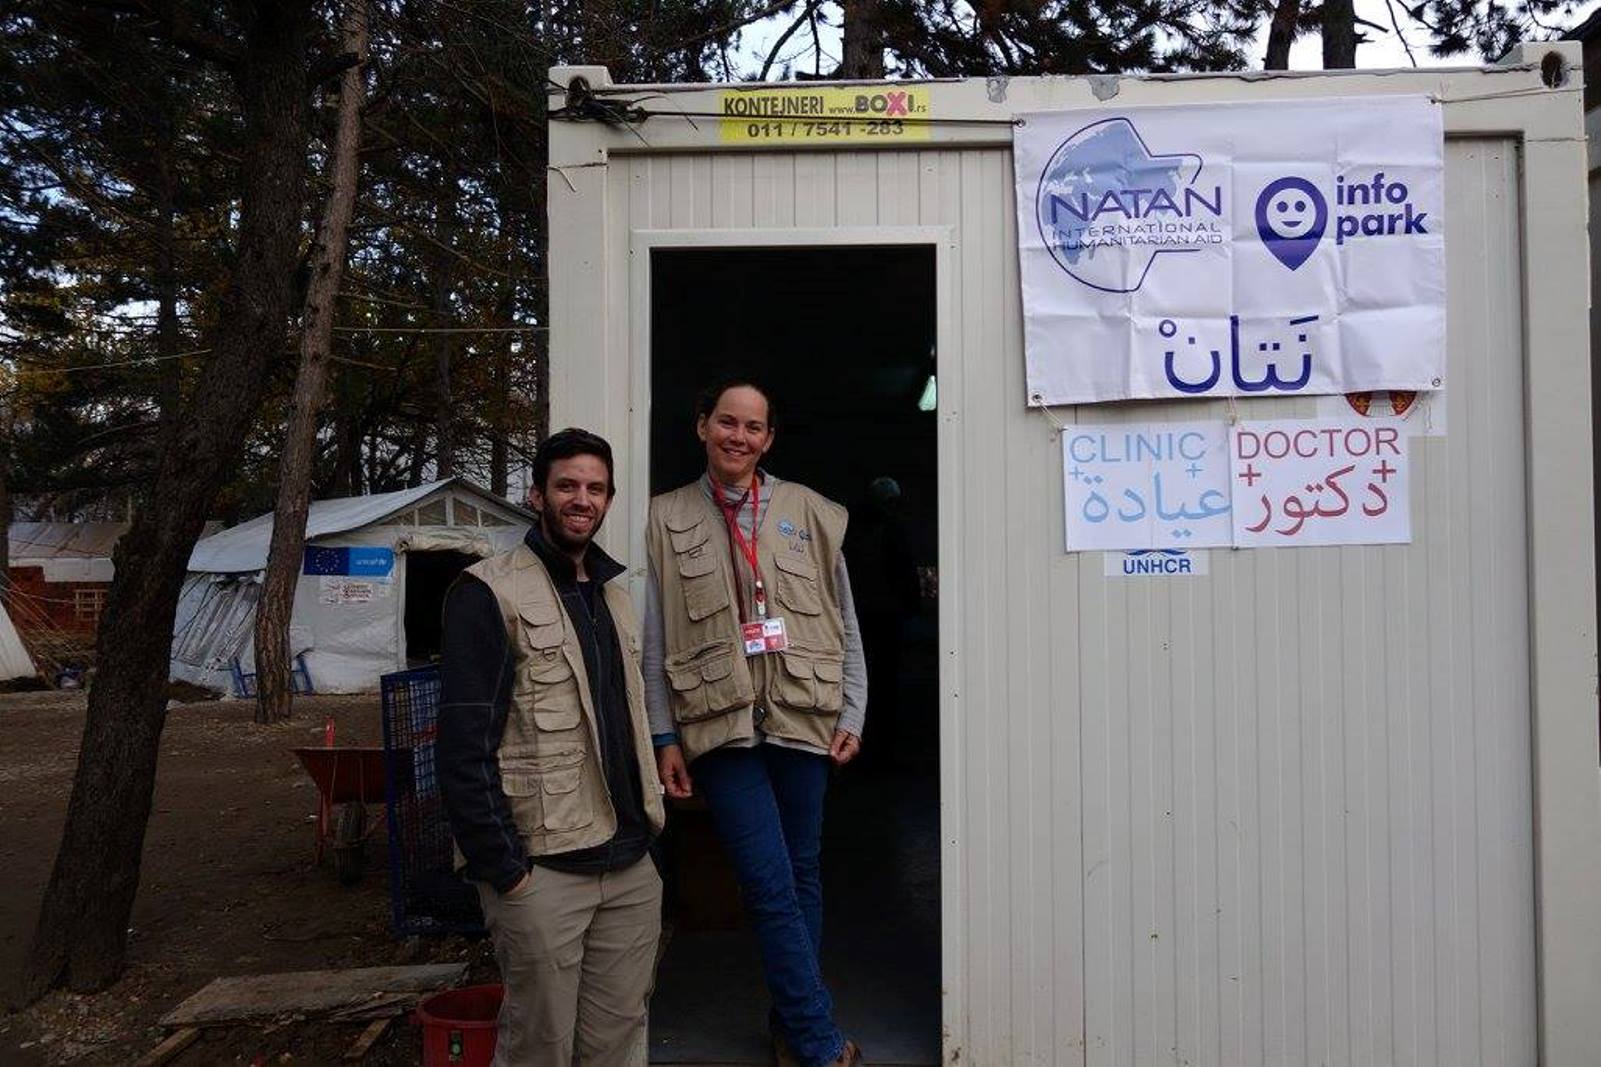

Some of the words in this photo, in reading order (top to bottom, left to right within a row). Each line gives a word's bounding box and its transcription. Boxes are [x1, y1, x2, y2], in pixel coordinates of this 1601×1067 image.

[724, 96, 824, 115] KONTEJNERI
[747, 123, 783, 137] 011
[803, 120, 851, 136] 7541
[1336, 172, 1408, 205] info
[1050, 186, 1221, 224] NATAN
[1052, 223, 1221, 239] INTERNATIONAL
[1336, 203, 1428, 245] park
[1053, 235, 1189, 251] HUMANITARIAN
[1194, 234, 1222, 244] AID
[1069, 432, 1207, 464] CLINIC
[1237, 427, 1401, 460] DOCTOR
[1083, 471, 1232, 538] عيادة
[1245, 465, 1389, 536] دكتور
[1123, 557, 1192, 575] UNHCR
